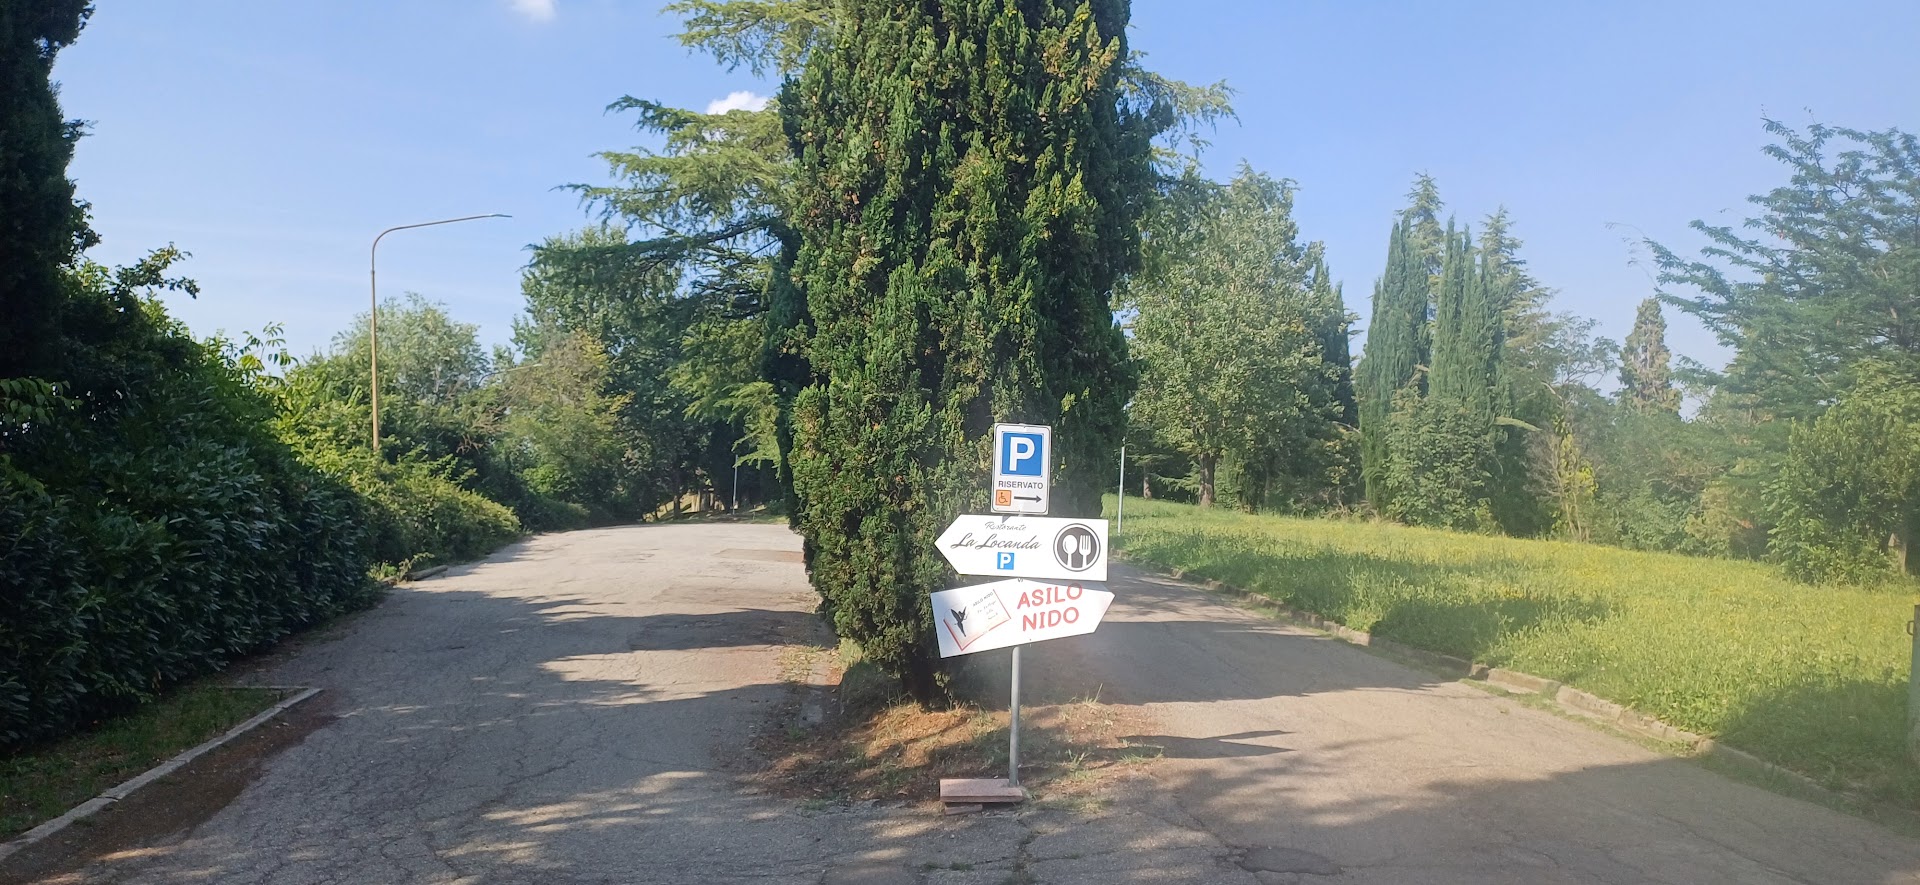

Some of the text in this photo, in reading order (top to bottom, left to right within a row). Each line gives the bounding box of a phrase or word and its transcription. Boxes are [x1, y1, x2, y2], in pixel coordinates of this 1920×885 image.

[1009, 436, 1035, 472] P
[998, 480, 1044, 490] RISERVATO
[984, 521, 1027, 531] Ristorante
[950, 532, 1042, 550] La Locanda
[1000, 553, 1011, 569] P
[1017, 582, 1083, 610] ASILO
[1022, 606, 1080, 632] NIDO
